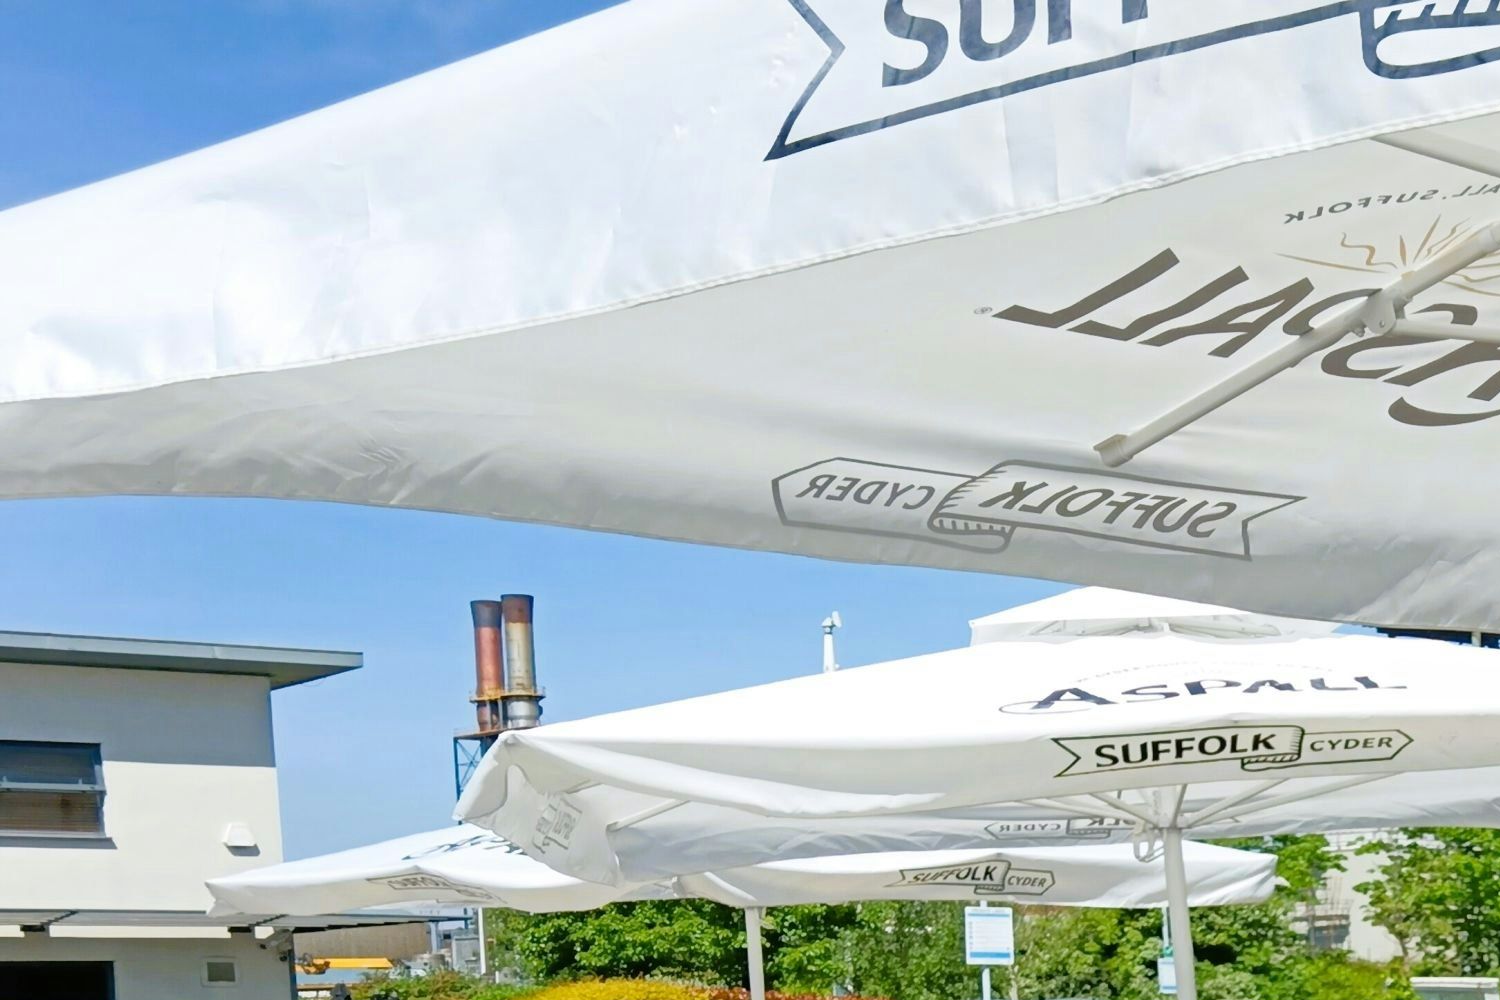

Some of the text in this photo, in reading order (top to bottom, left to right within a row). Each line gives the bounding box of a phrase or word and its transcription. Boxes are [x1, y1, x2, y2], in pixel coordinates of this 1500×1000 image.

[998, 675, 1408, 715] ASPALL
[1094, 732, 1394, 768] SUFFOLK CYDER
[912, 862, 1047, 889] SUFFOLK CYDER
